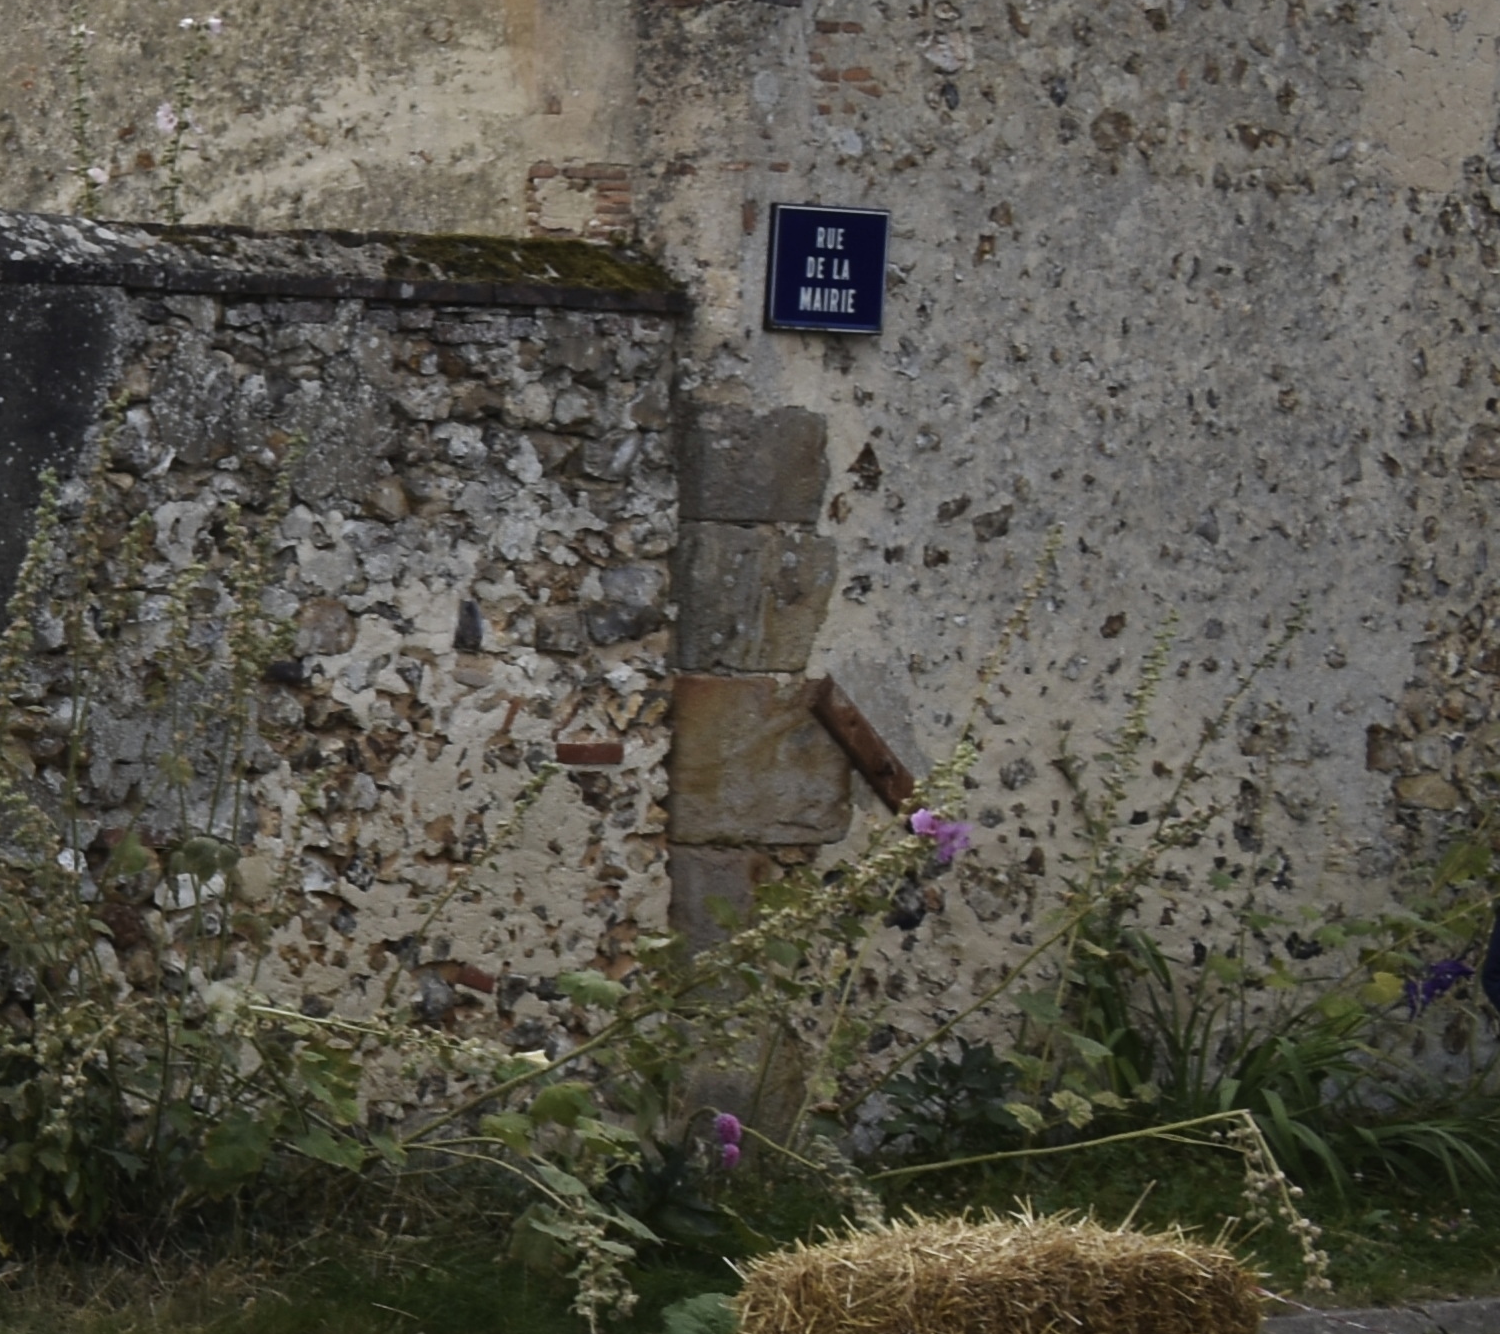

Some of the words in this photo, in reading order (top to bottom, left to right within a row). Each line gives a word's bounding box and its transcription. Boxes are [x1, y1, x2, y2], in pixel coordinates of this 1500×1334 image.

[815, 226, 846, 250] RUE
[805, 256, 826, 279] DE
[832, 258, 851, 281] LA
[798, 286, 857, 313] MAIRIE
